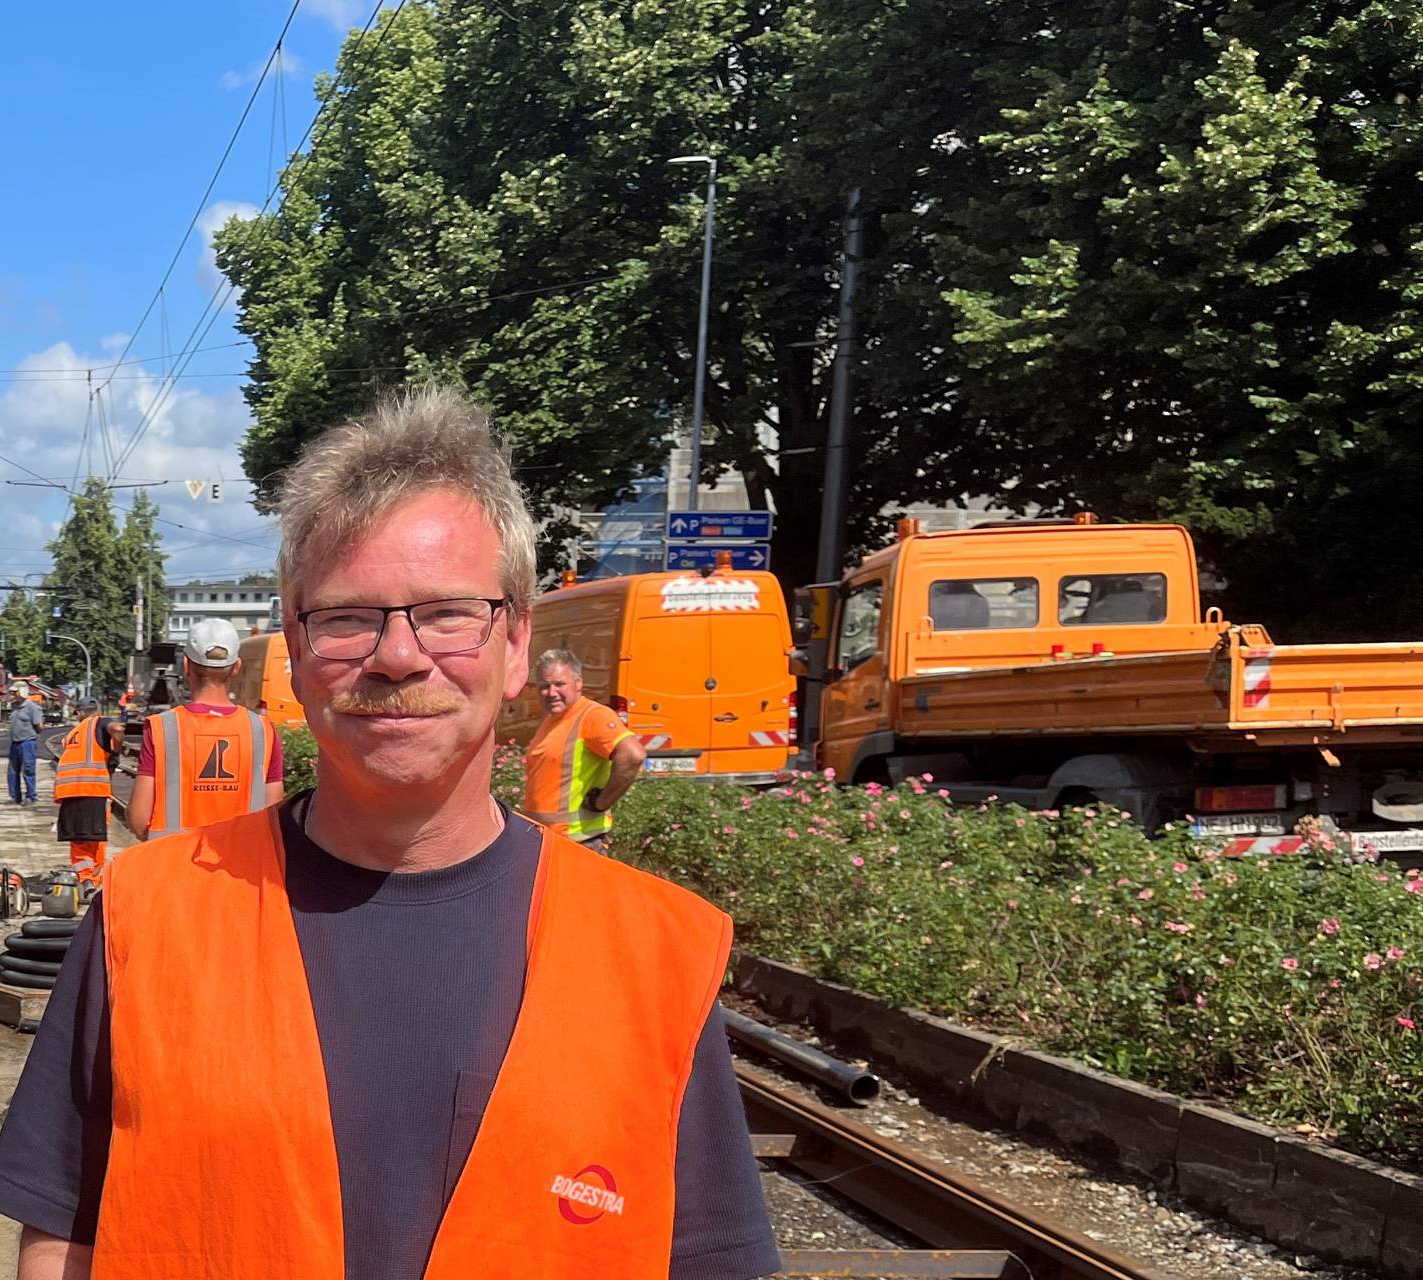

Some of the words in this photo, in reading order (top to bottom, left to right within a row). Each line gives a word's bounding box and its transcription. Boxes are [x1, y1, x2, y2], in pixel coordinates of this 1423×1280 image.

[212, 484, 219, 499] E
[690, 519, 699, 531] P
[669, 552, 678, 563] P
[193, 784, 239, 792] REISSE-BAU
[550, 1174, 625, 1216] BOGESTRA
